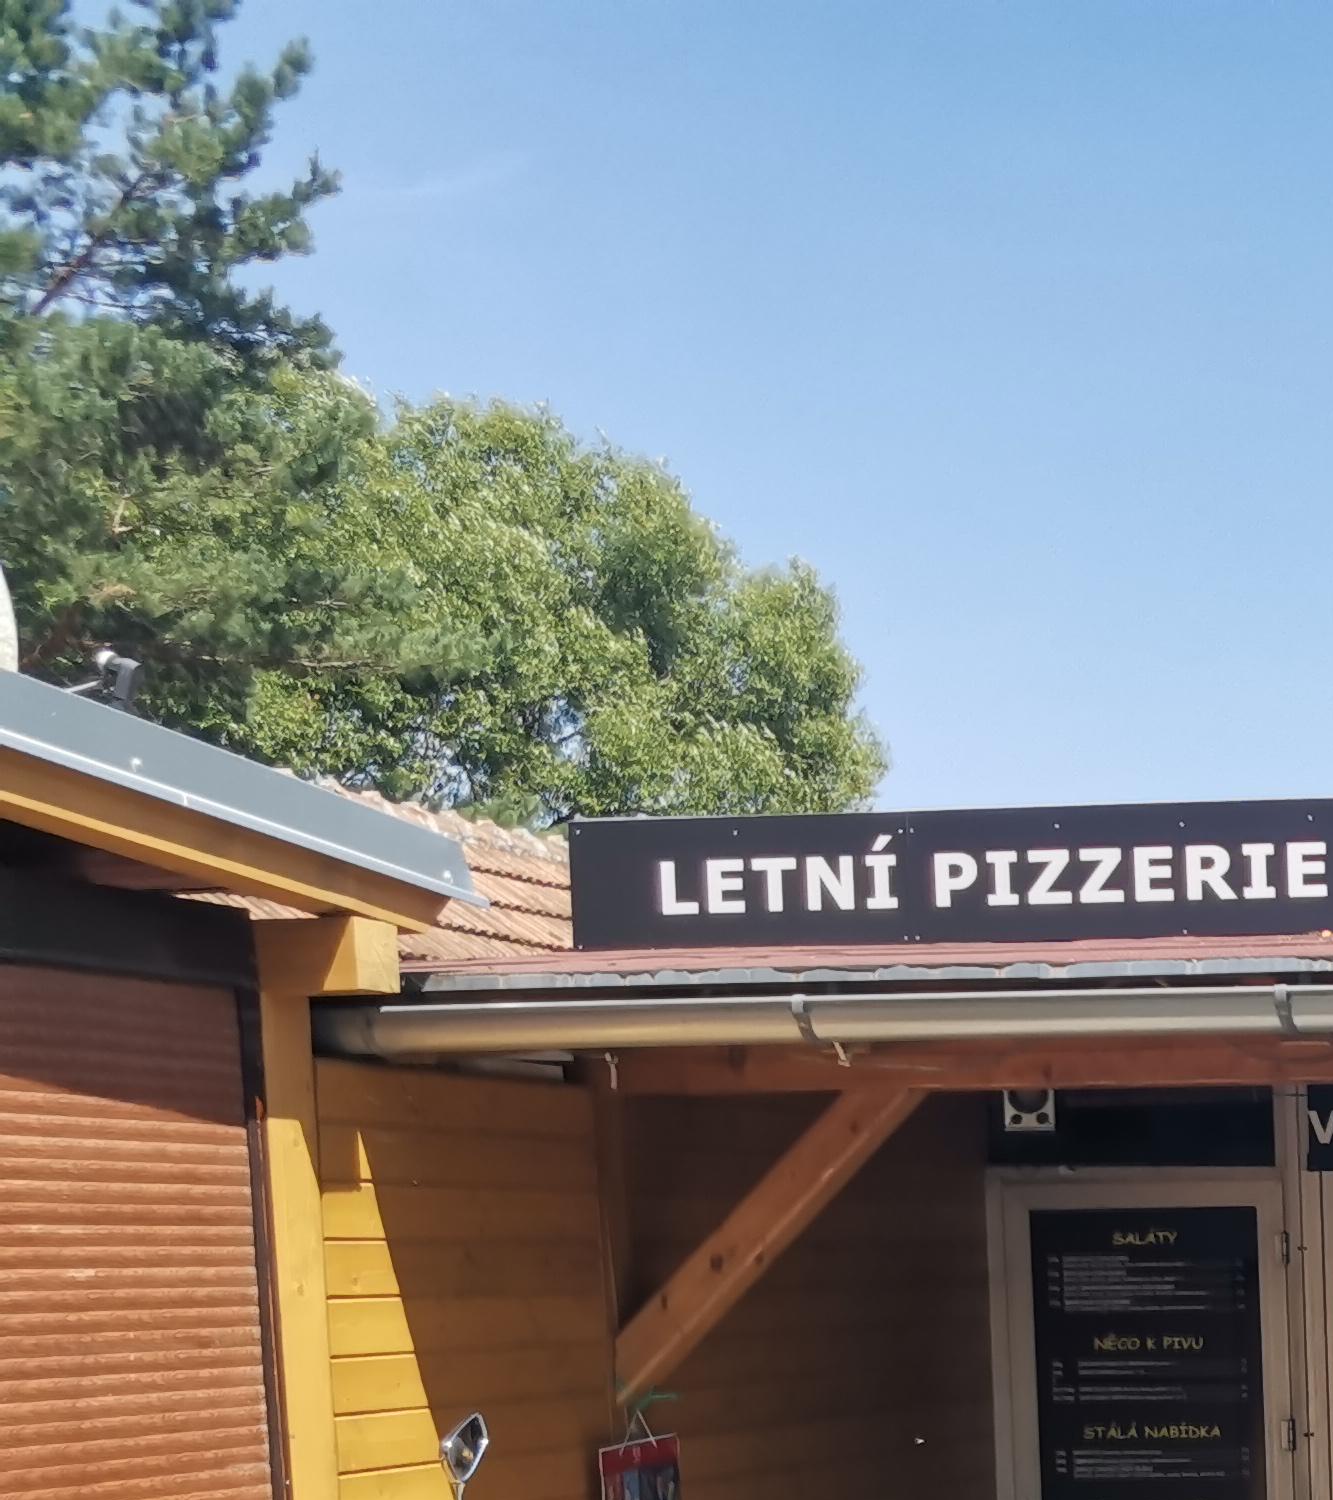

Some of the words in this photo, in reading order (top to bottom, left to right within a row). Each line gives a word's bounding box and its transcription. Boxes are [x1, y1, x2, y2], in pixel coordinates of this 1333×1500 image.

[658, 835, 898, 915] LETNÍ
[932, 841, 1329, 908] PIZZERIE
[1146, 1337, 1156, 1350] K
[1163, 1336, 1204, 1350] PIVU
[1144, 1421, 1222, 1439] NABÍDKA
